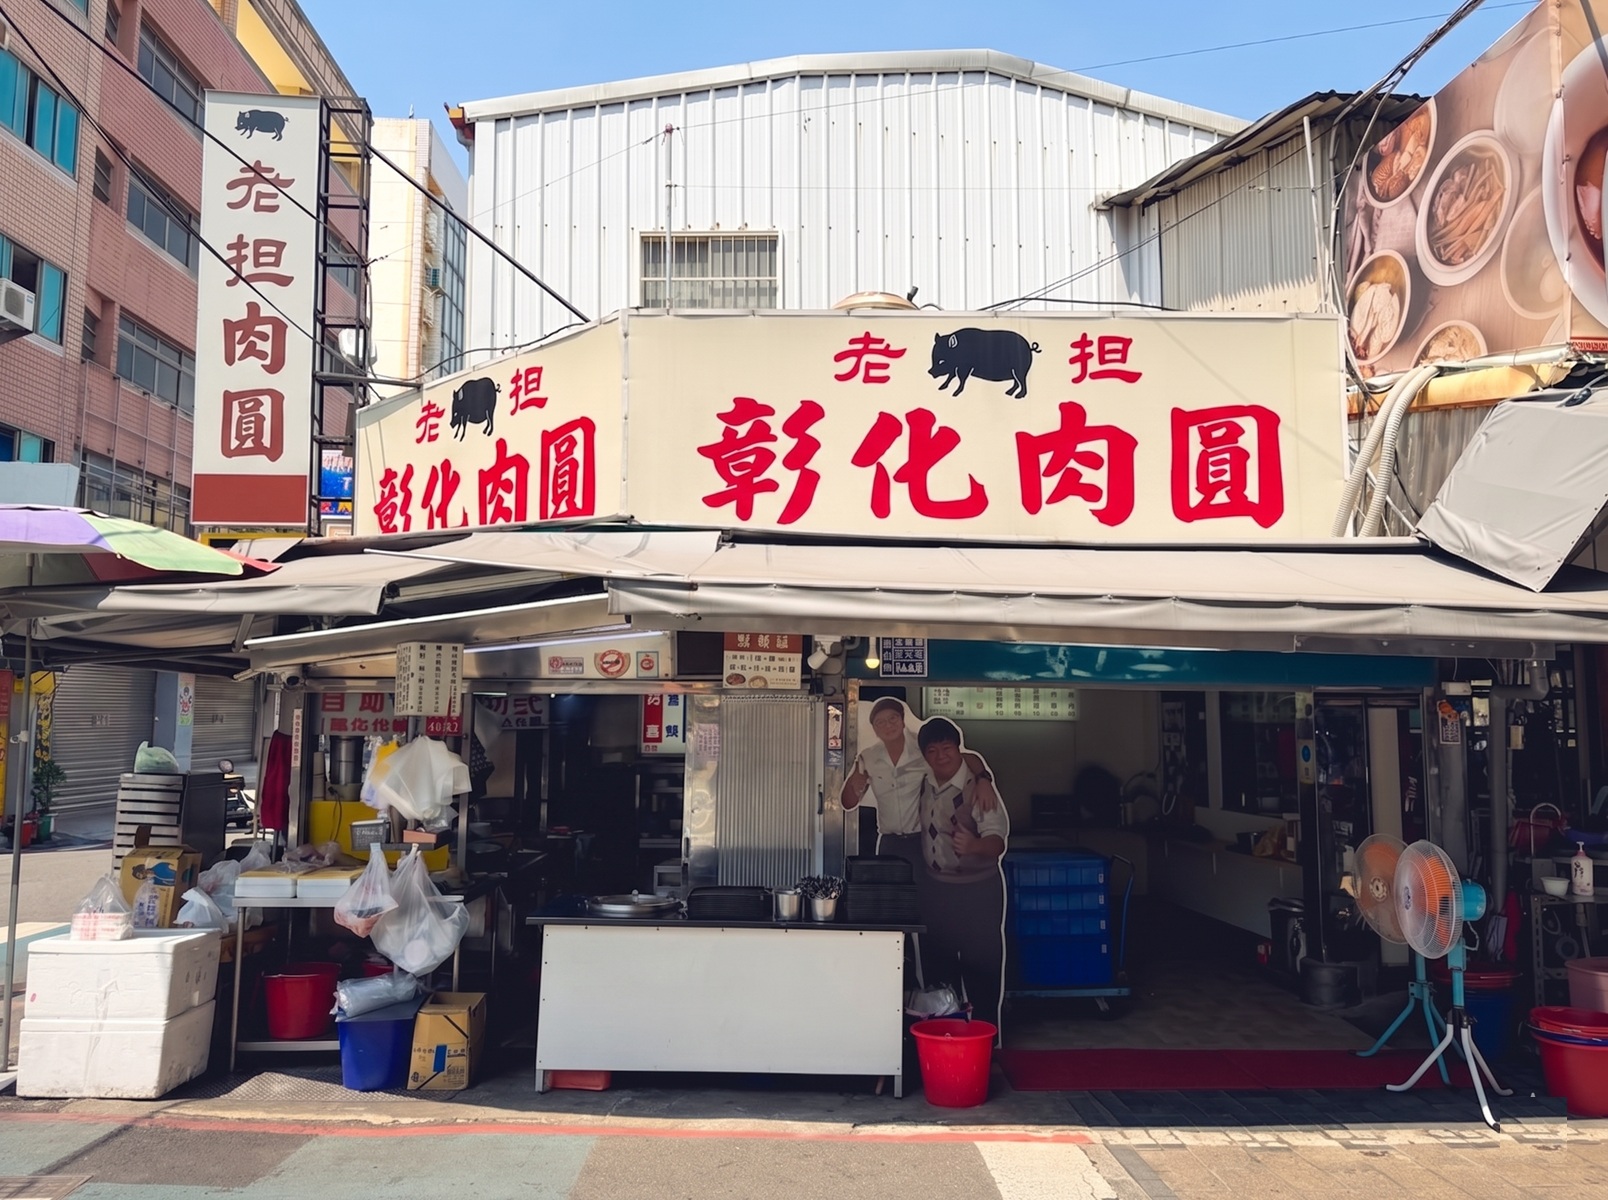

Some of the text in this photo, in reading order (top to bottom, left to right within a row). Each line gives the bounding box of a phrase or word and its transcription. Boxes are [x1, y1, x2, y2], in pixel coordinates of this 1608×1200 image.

[415, 365, 549, 444] 老 担
[833, 331, 1143, 385] 老 担
[373, 416, 596, 534] 彰化肉圓
[697, 396, 1286, 529] 彰化肉圓
